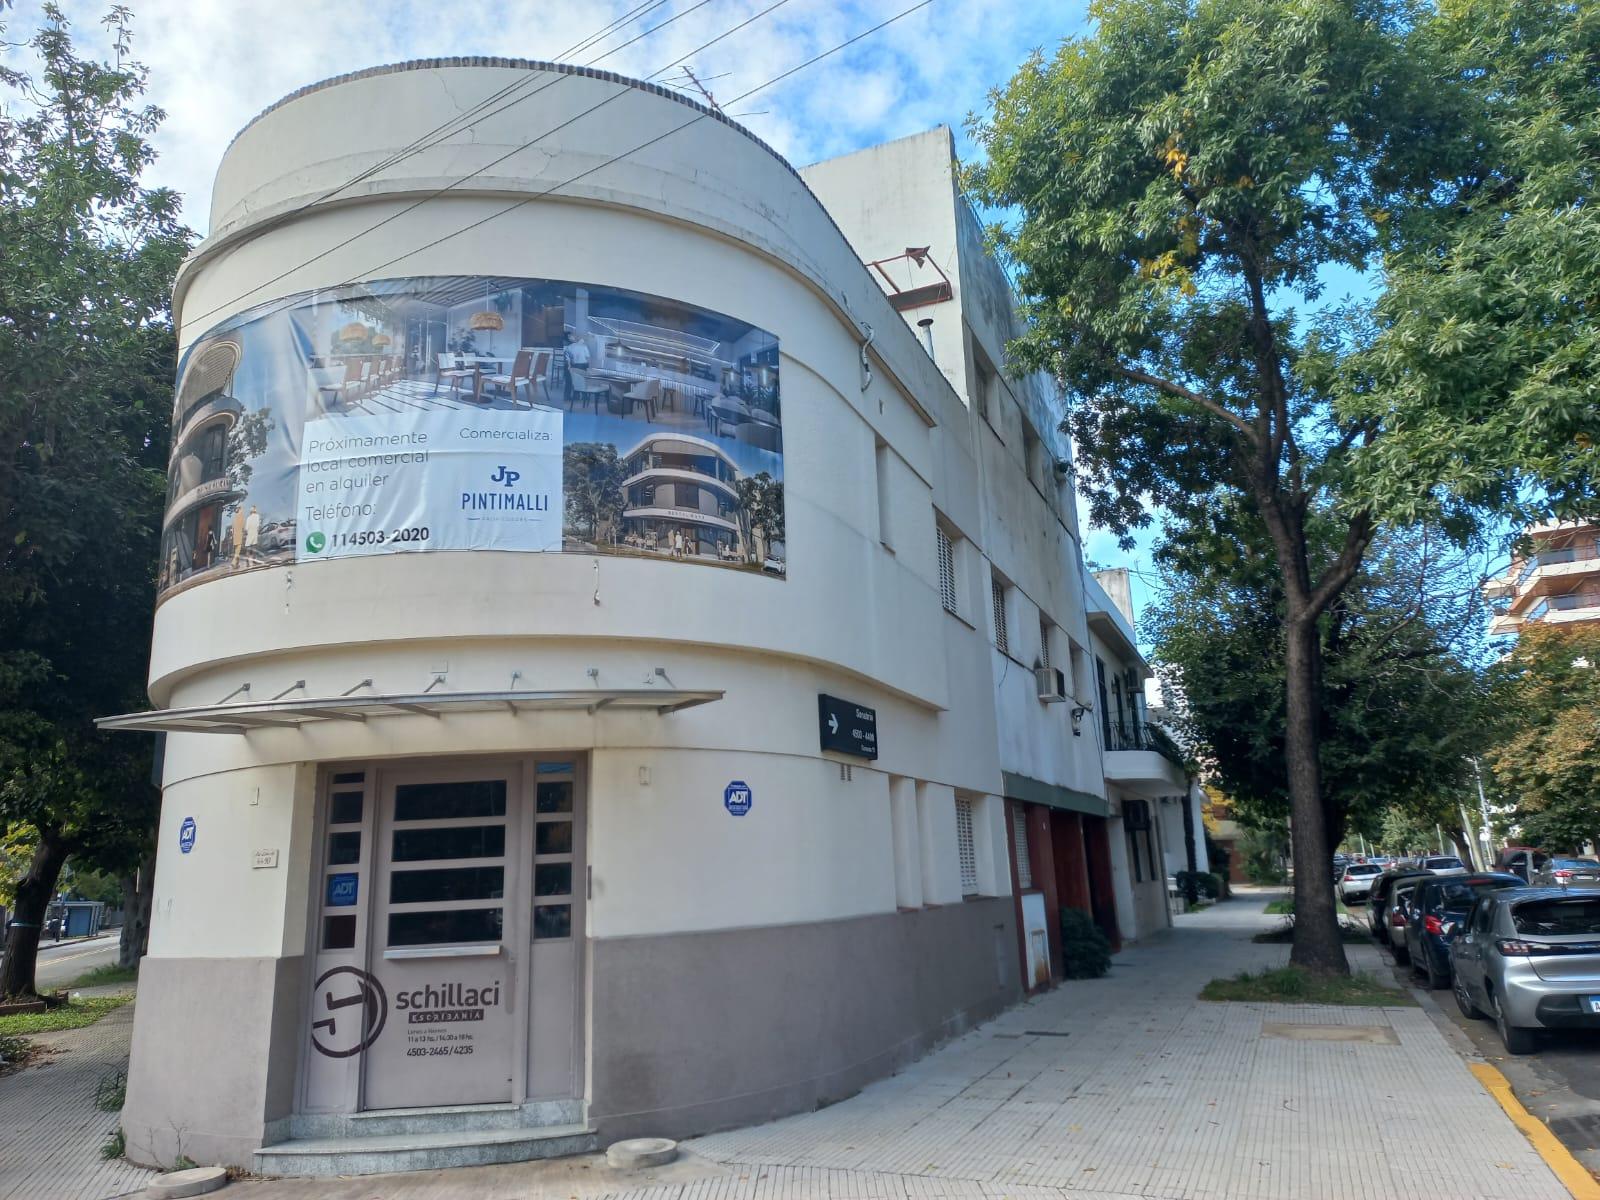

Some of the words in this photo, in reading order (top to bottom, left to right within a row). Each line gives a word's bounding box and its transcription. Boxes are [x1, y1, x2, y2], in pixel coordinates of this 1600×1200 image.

[308, 431, 428, 453] Próximamente
[459, 427, 553, 441] Comercializa:
[307, 457, 342, 472] local
[348, 450, 429, 468] comercial
[305, 481, 324, 493] en
[329, 473, 389, 491] alquiler
[461, 492, 548, 511] PINTIMALLI
[305, 503, 376, 520] Teléfono:
[332, 527, 430, 547] 114503-2020
[728, 790, 748, 804] ADT
[181, 826, 195, 841] ADT
[333, 882, 355, 896] ADT
[395, 980, 500, 1010] schillaci
